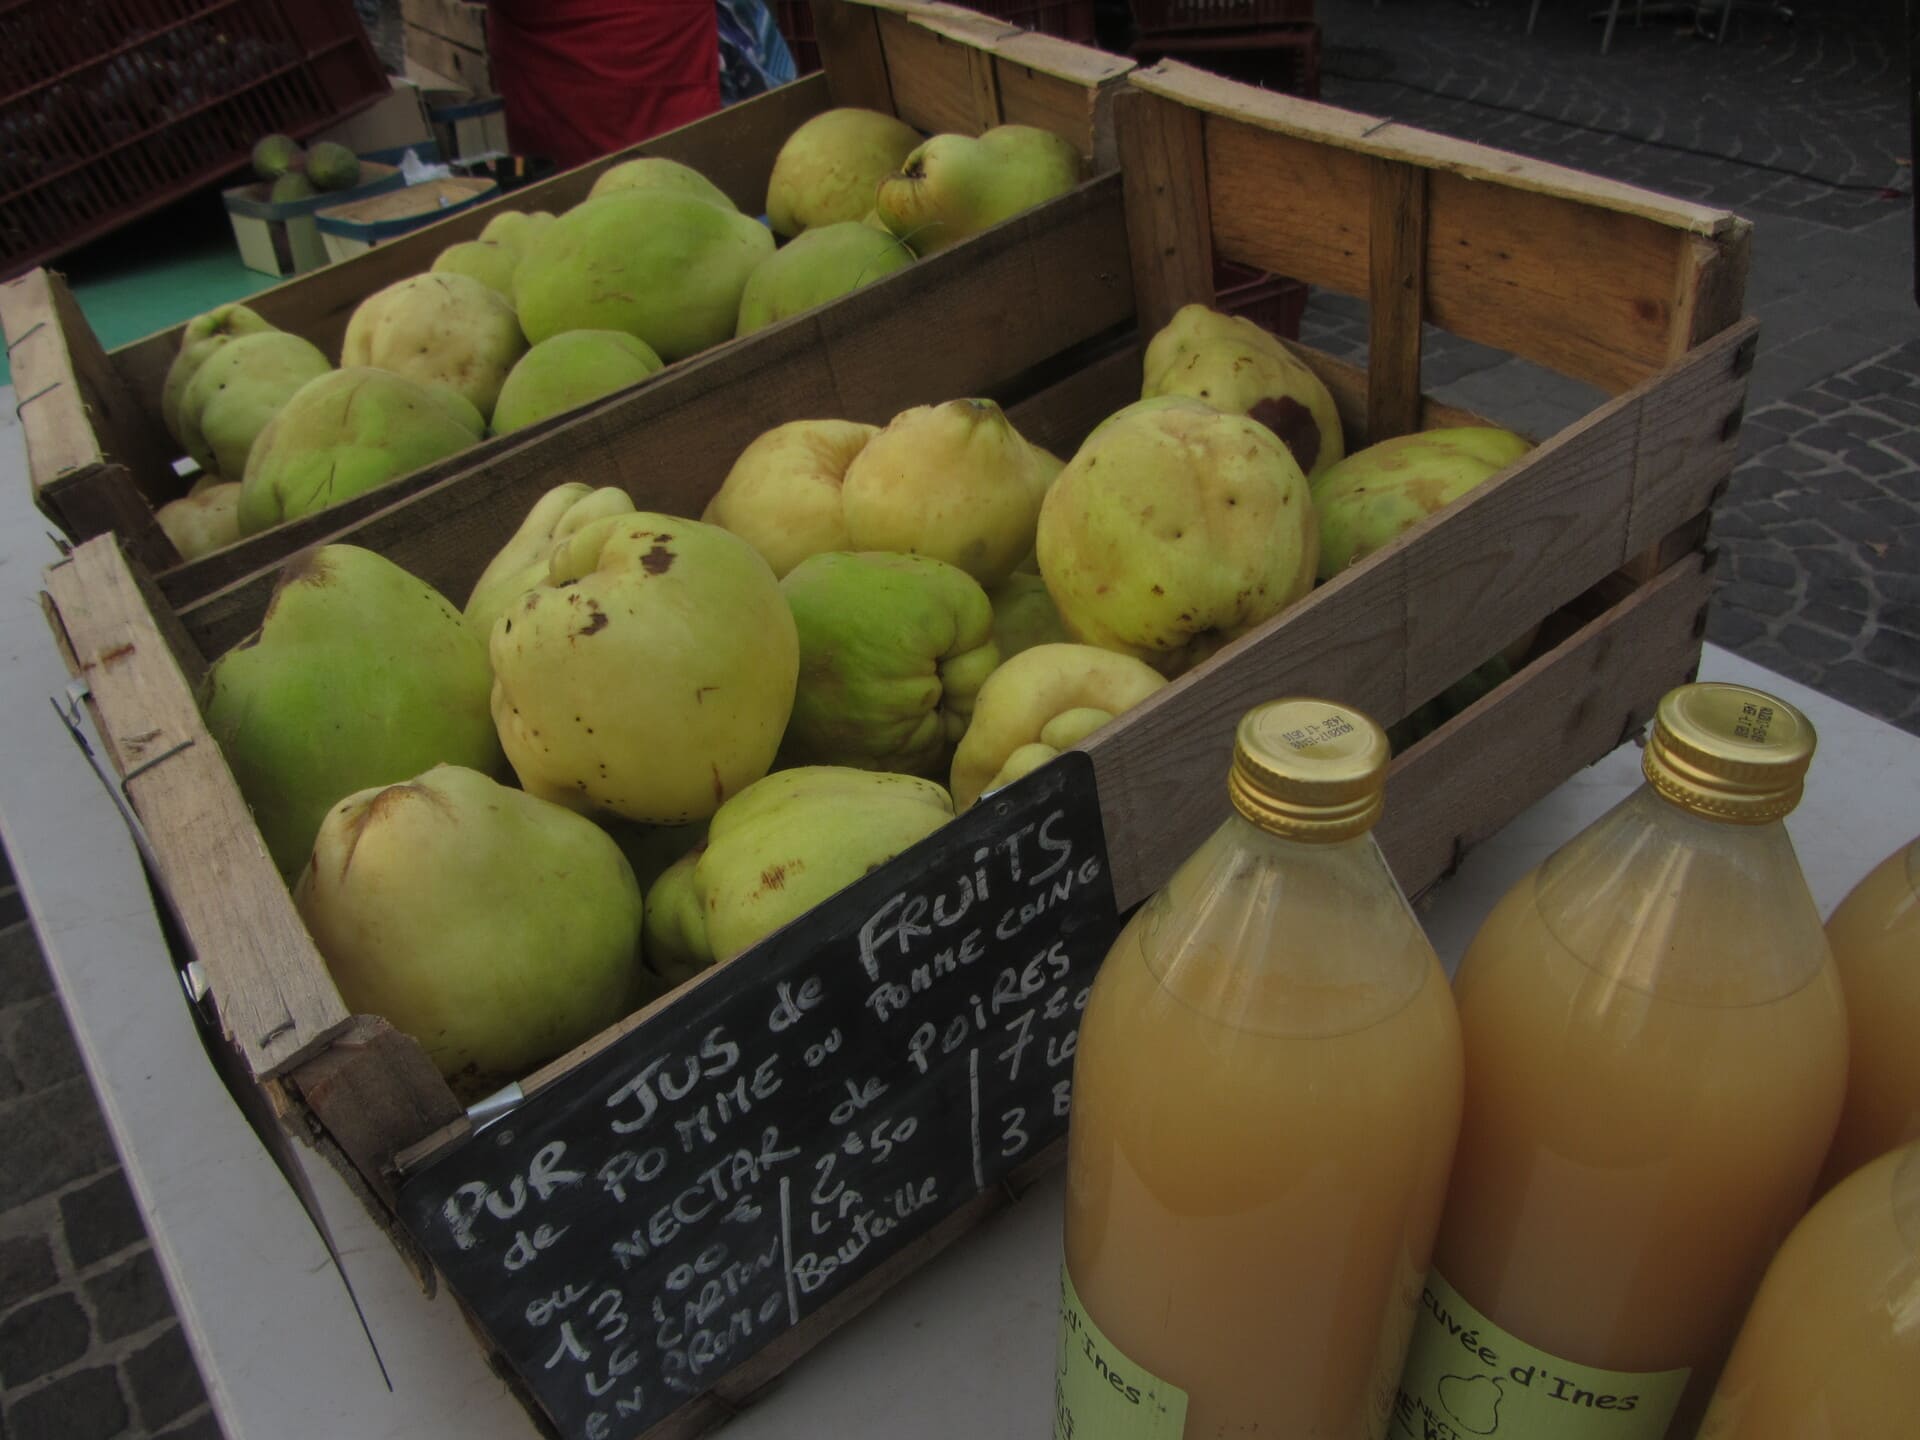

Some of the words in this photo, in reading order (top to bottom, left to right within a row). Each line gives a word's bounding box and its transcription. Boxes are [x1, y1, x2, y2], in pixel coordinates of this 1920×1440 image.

[442, 1140, 586, 1250] PUR
[605, 1025, 740, 1134] JUS
[769, 976, 824, 1032] de
[504, 1223, 571, 1271] de
[597, 1053, 783, 1203] POMME
[865, 928, 985, 1022] POMME
[996, 855, 1099, 940] COING
[1001, 1107, 1029, 1156] 3
[611, 1125, 801, 1270] NECTAR
[829, 1076, 889, 1126] de
[656, 1234, 778, 1350] CARTON
